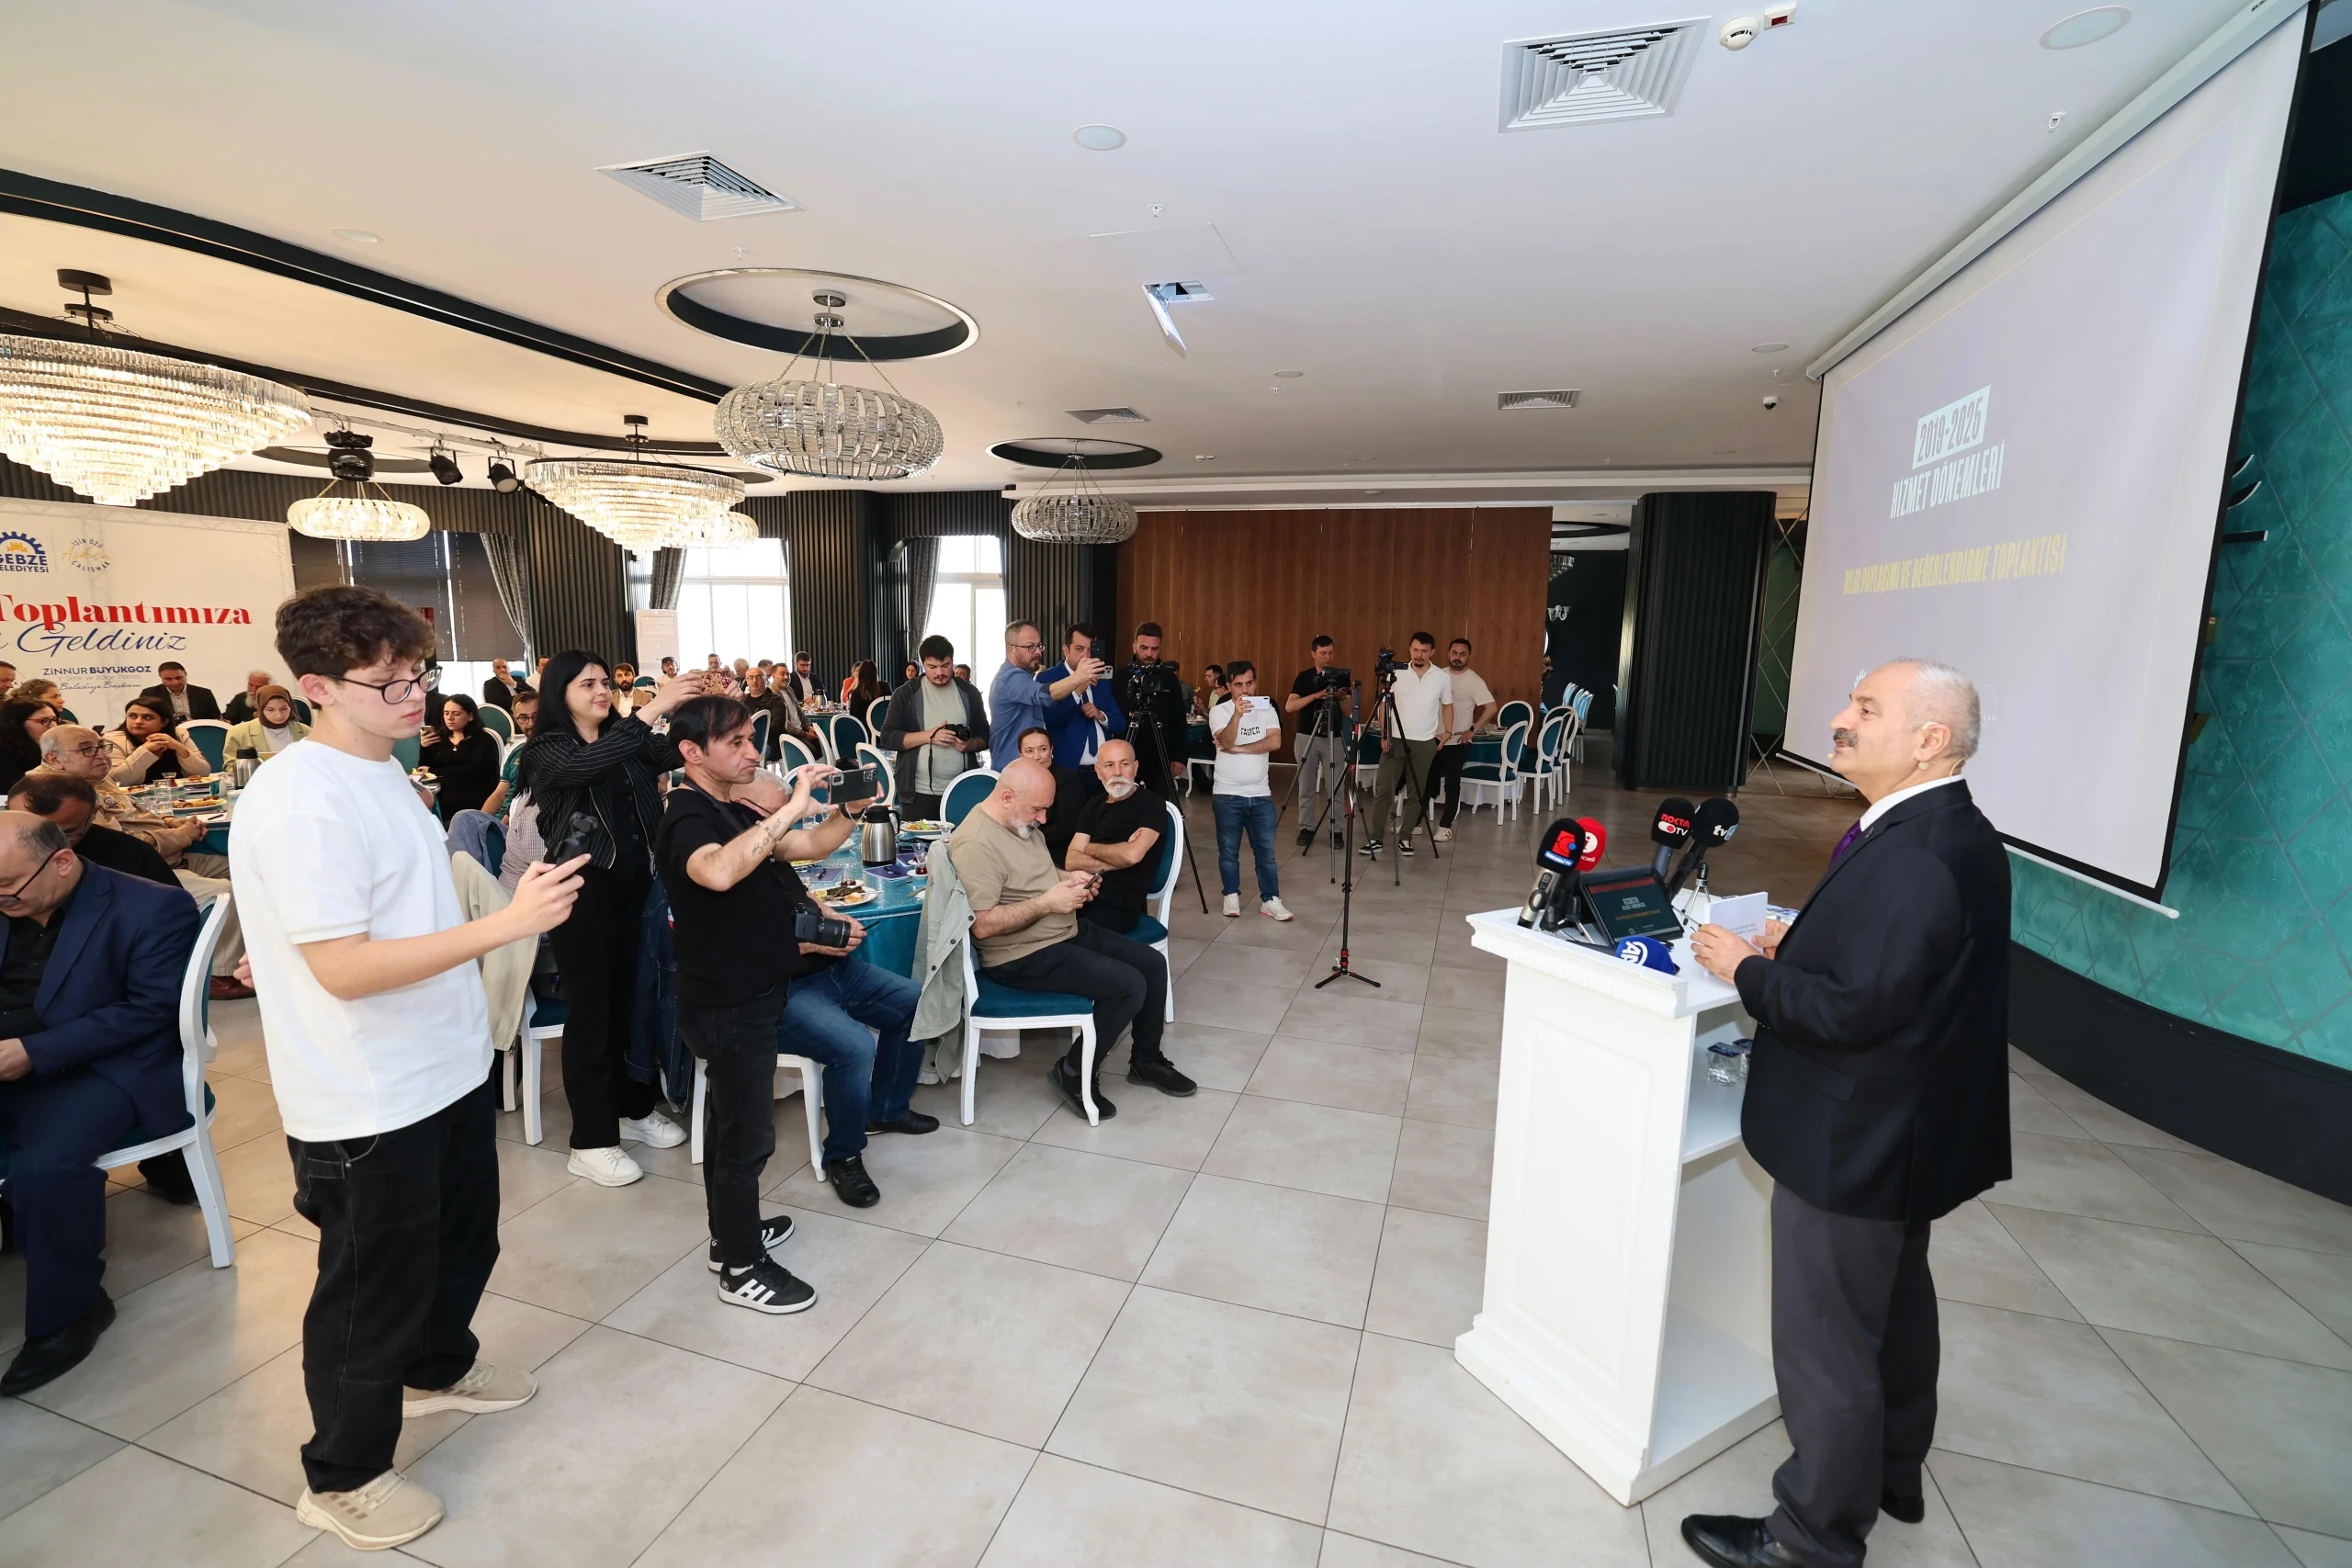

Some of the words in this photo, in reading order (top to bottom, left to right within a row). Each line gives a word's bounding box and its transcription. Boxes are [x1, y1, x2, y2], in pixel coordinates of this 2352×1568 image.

[1917, 395, 1984, 463] 2019-2025
[1890, 471, 1931, 519] HİZMET
[1929, 439, 2006, 508] DÖNEMLERİ
[0, 564, 50, 573] ELEDİYESİ
[71, 560, 111, 573] ÇALIŞMAK
[1991, 532, 2068, 581] TOPLANTISI
[17, 621, 187, 658] Geldiniz
[42, 667, 88, 676] ZİNNUR
[1676, 827, 1689, 837] TV
